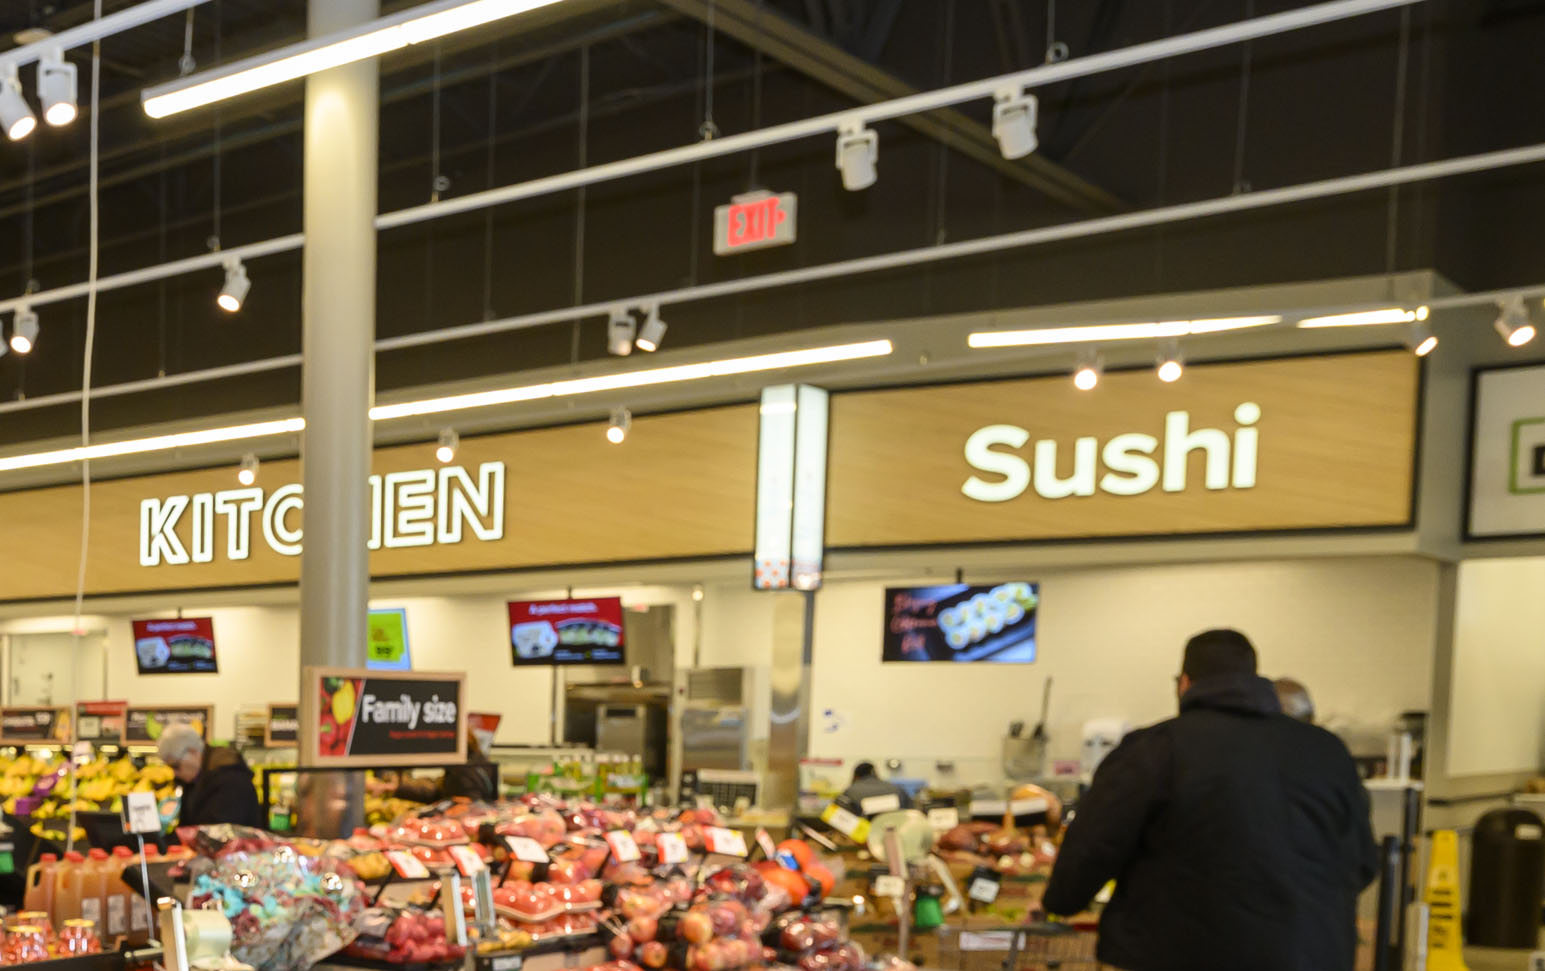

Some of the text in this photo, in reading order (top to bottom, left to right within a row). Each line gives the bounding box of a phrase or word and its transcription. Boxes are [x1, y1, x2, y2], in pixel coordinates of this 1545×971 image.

[728, 197, 779, 246] EXIT
[961, 402, 1261, 502] Sushi
[140, 461, 505, 566] KITCEN
[361, 694, 457, 729] Family size
